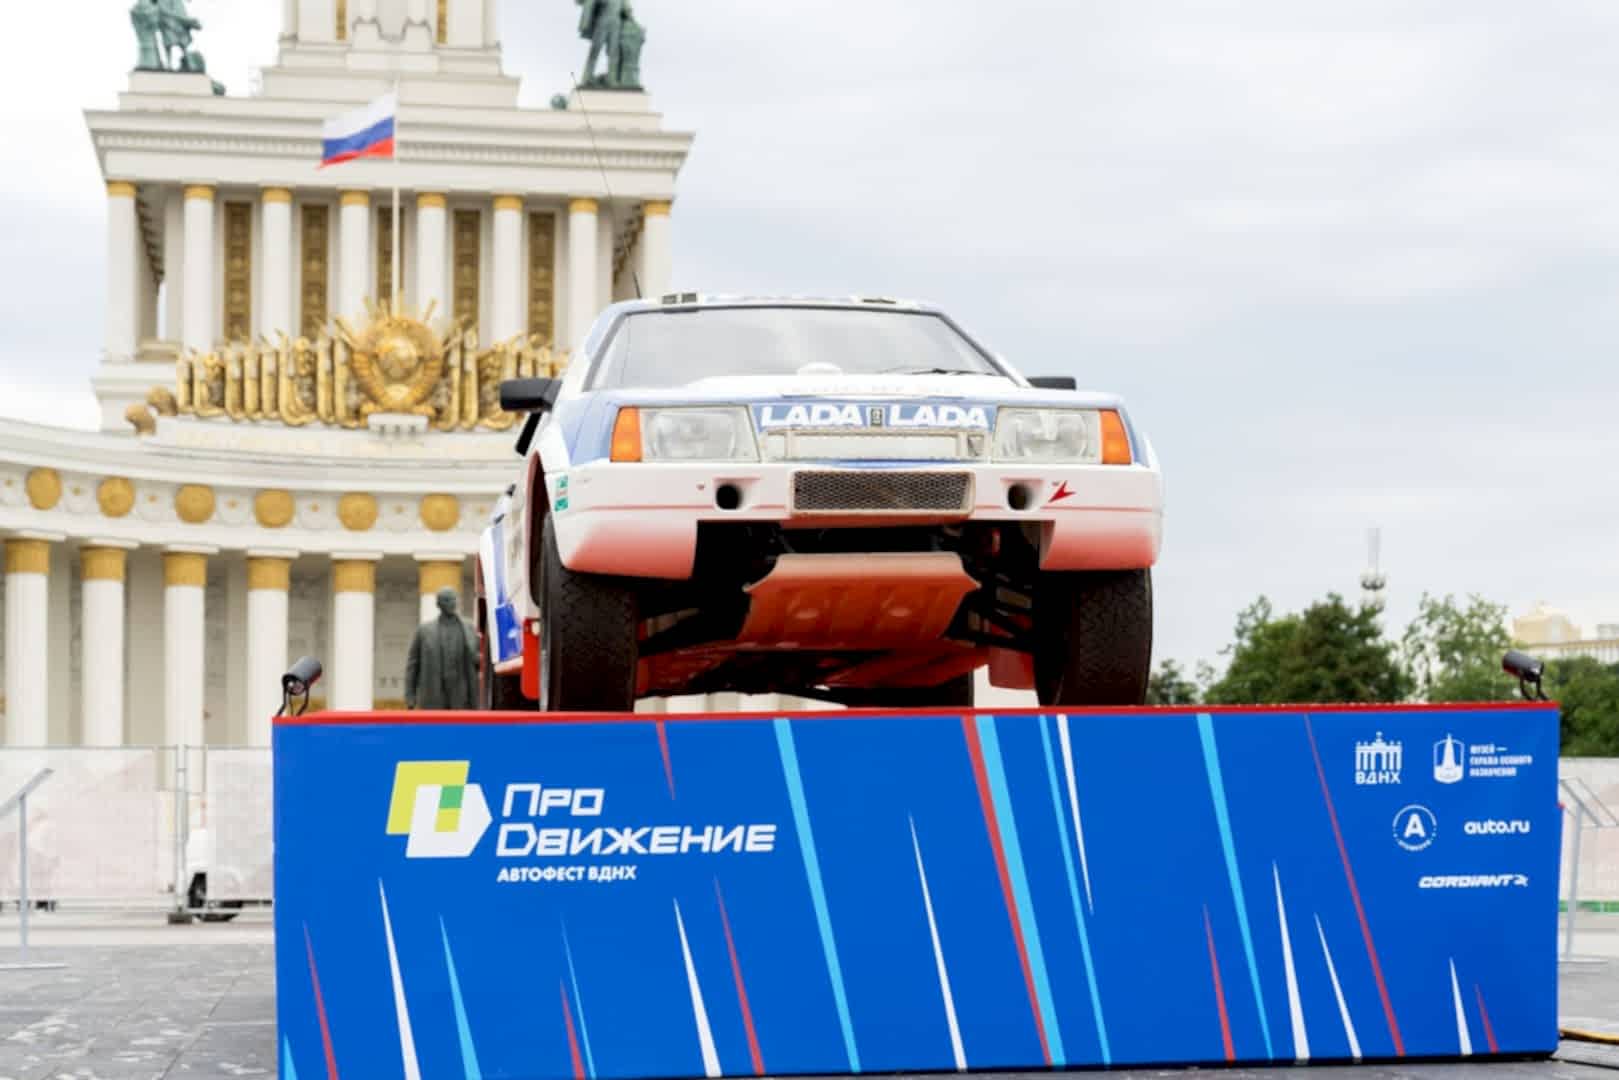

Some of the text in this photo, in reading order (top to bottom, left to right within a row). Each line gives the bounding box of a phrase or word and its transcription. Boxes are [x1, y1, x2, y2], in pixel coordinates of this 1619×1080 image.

[761, 405, 989, 427] LADA LADA
[1355, 771, 1402, 785] ВДНХ
[1464, 819, 1530, 835] auto.ru
[497, 865, 638, 882] АВТОФЕСТ ВДНХ
